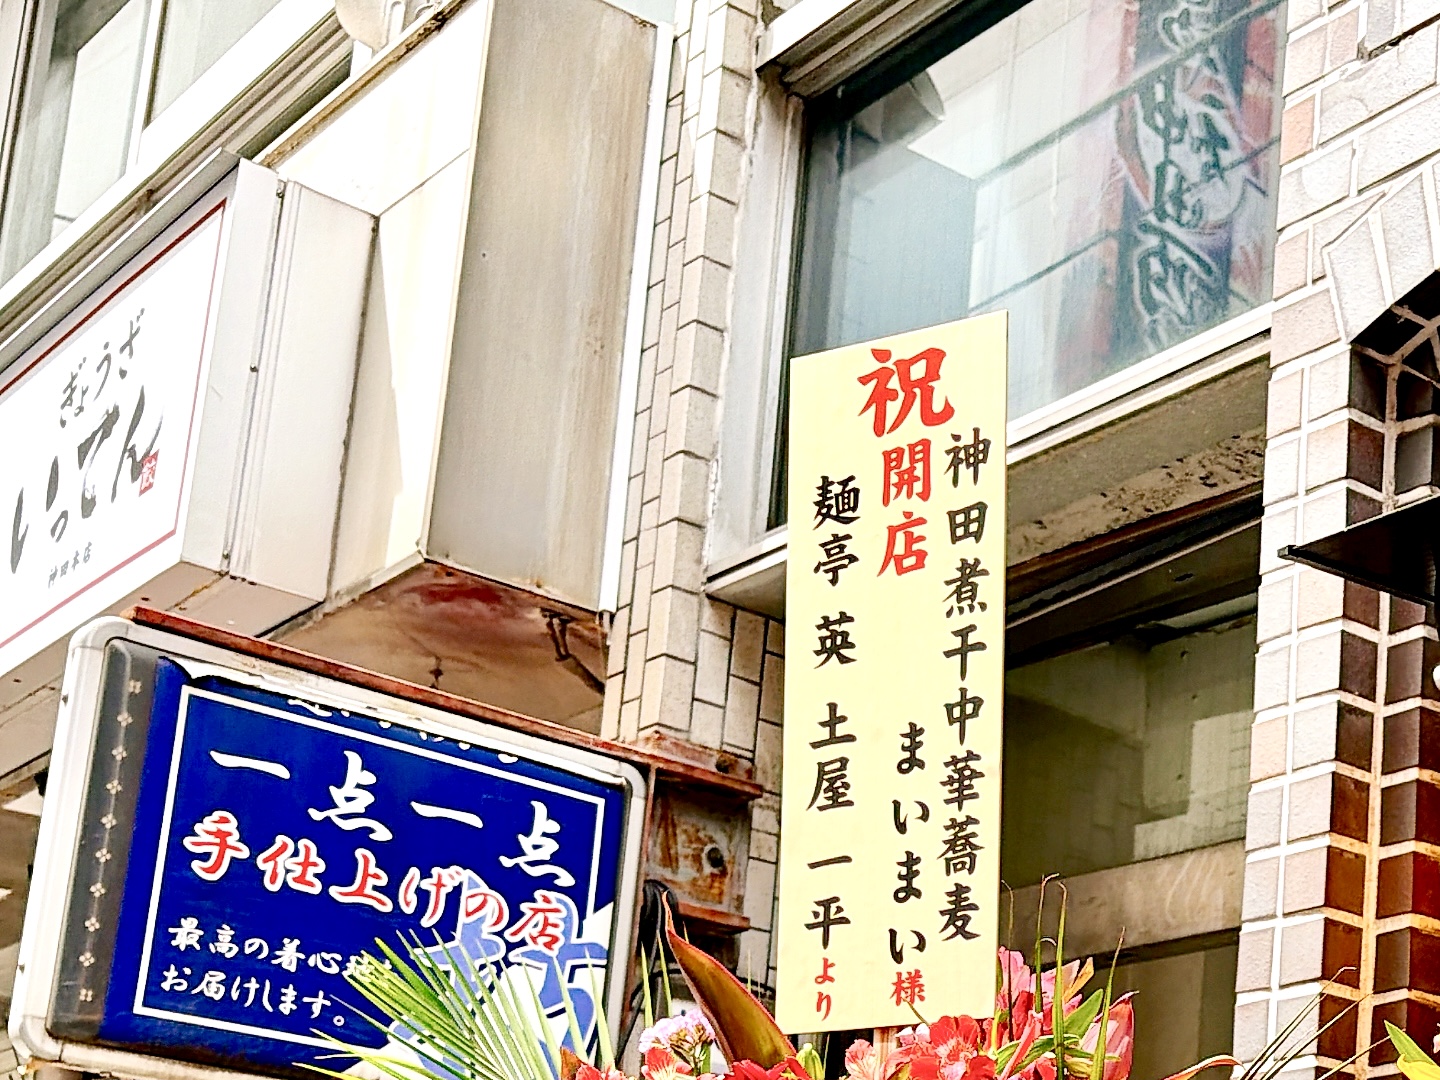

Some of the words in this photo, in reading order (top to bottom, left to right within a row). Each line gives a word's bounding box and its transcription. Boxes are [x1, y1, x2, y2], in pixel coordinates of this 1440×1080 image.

[61, 308, 145, 428] ぎょうざ
[10, 385, 164, 574] いってん
[938, 427, 992, 942] 神田煮干中華蕎麦
[183, 810, 570, 954] 手仕上げの店
[210, 750, 576, 887] 一点一点
[160, 963, 345, 1027] お届けします。
